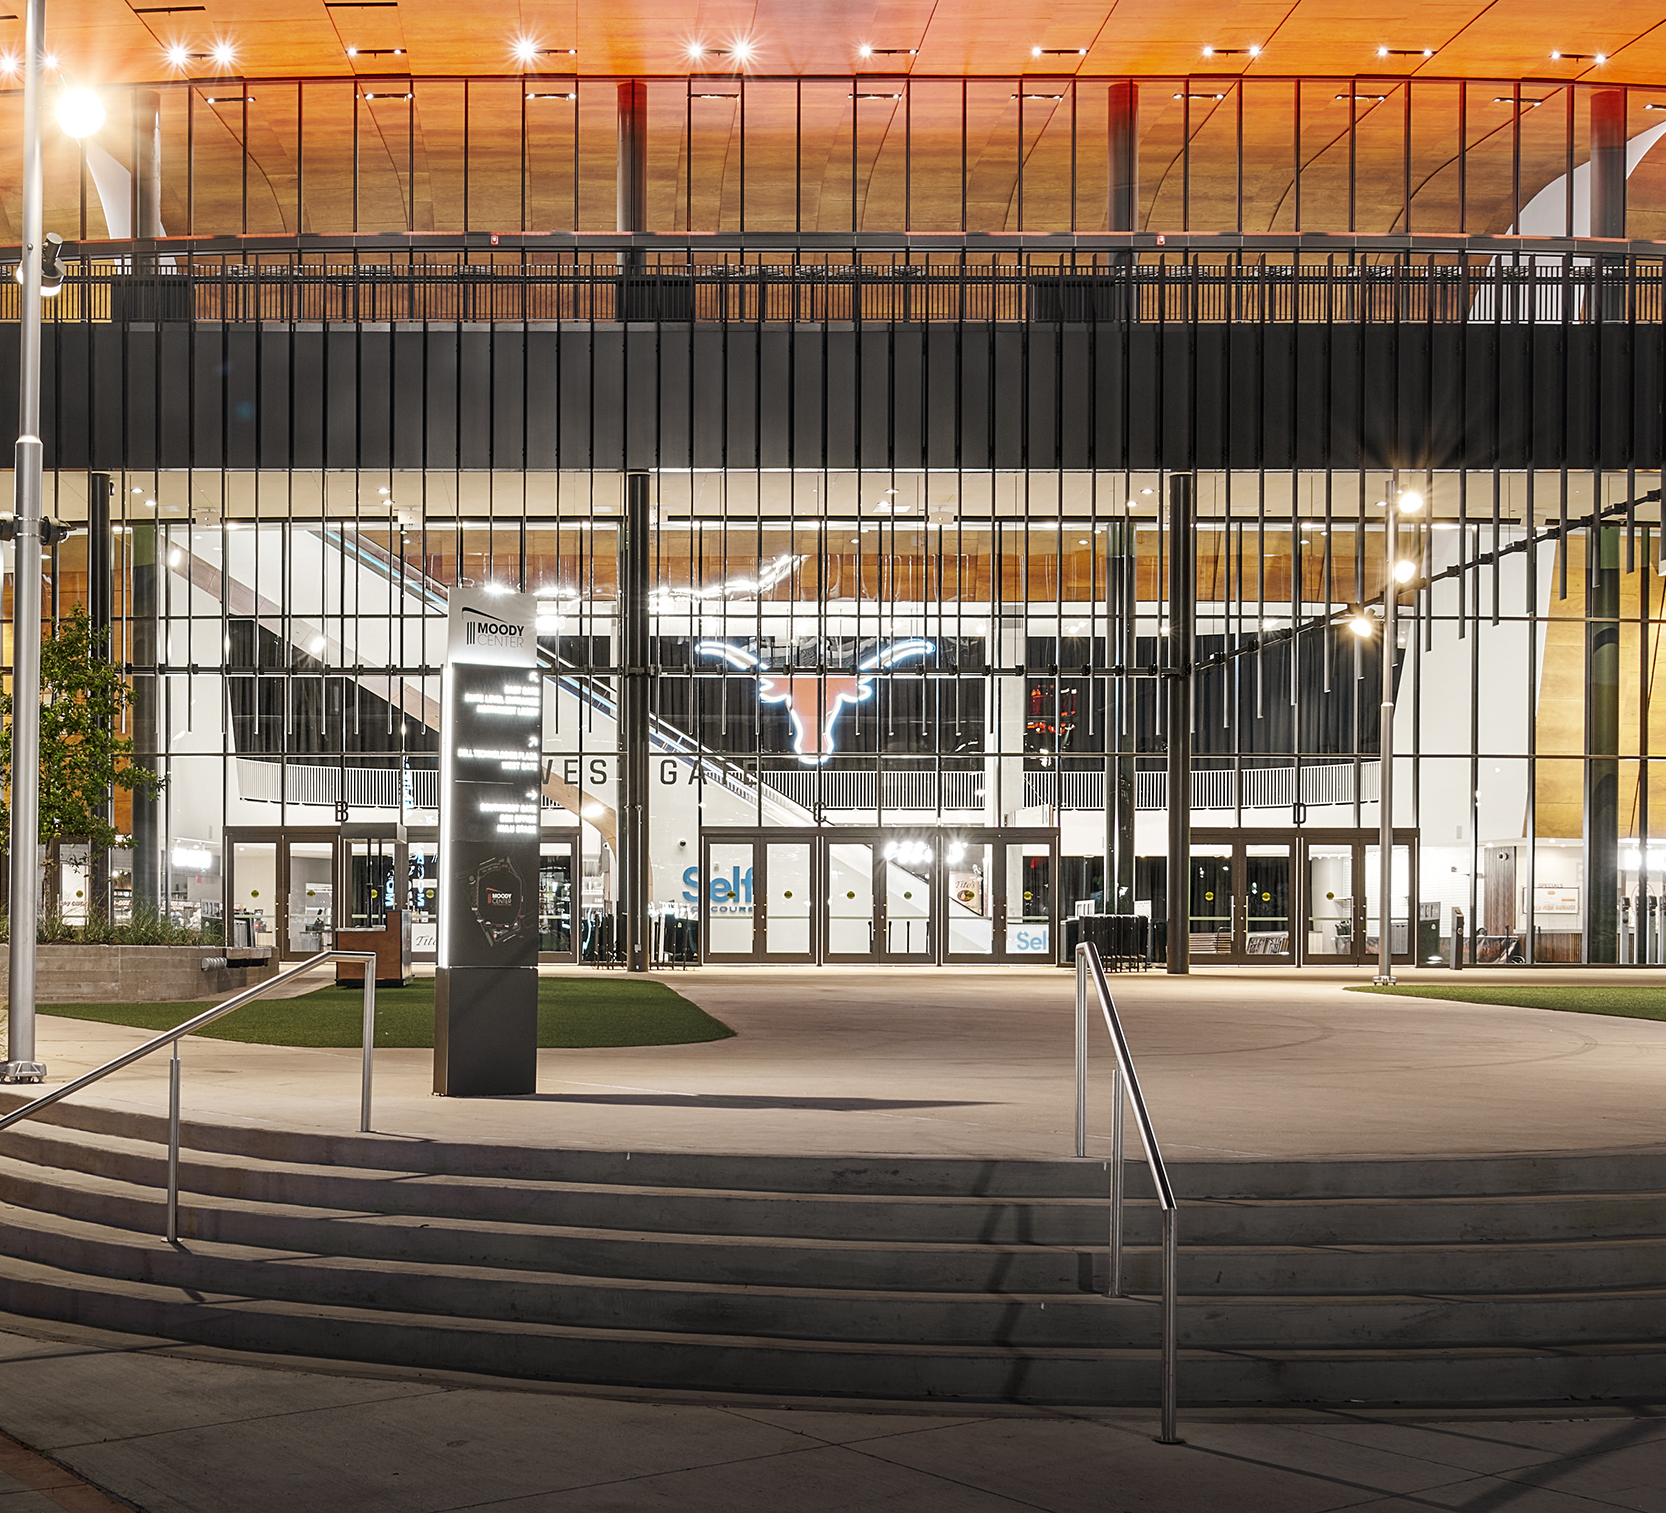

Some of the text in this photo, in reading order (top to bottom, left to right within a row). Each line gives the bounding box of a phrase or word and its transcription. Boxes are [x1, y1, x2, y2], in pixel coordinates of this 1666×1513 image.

[477, 622, 524, 636] MOODY
[477, 634, 525, 648] CENTER
[335, 800, 349, 822] B
[813, 802, 827, 823] C
[1293, 803, 1307, 824] D
[682, 865, 754, 903] Self
